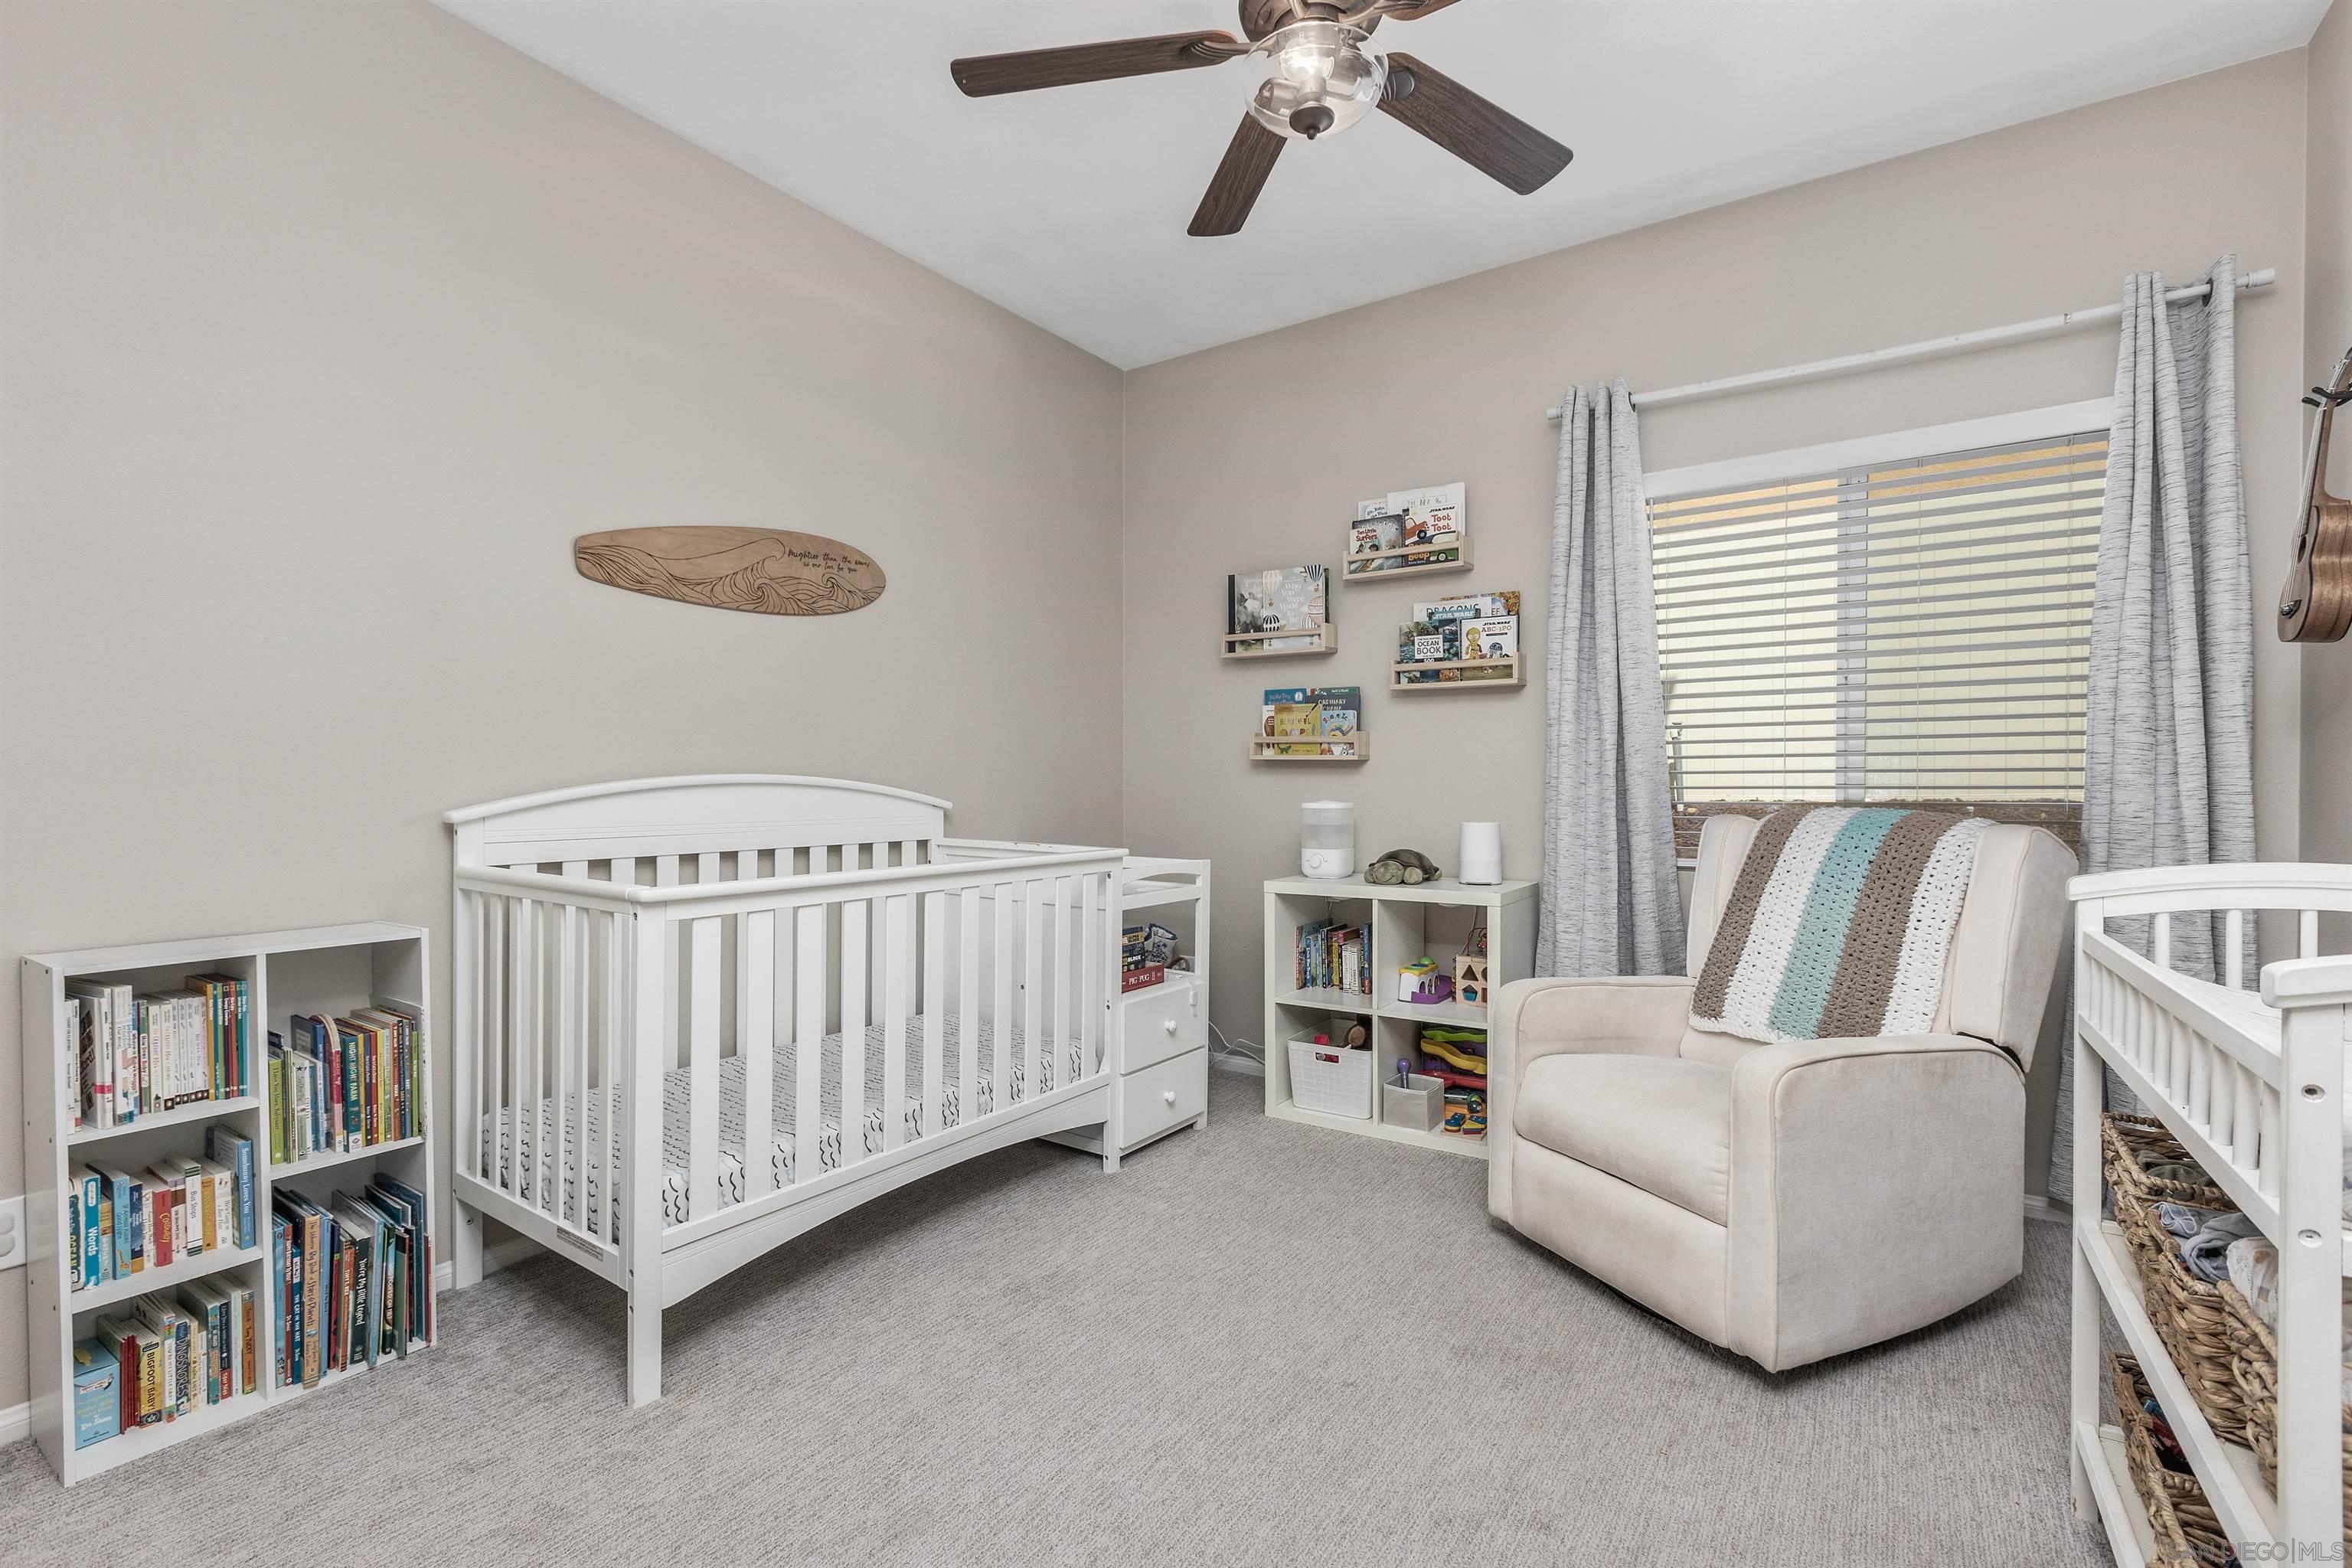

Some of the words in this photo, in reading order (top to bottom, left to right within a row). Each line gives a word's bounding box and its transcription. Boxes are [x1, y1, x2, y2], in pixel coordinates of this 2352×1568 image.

[1431, 513, 1452, 522] Toot
[1431, 523, 1452, 532] Toot
[822, 553, 837, 562] than
[842, 555, 851, 564] the
[1285, 583, 1302, 591] Who
[1279, 603, 1298, 611] Made
[1139, 974, 1149, 982] PUG
[350, 1083, 358, 1101] FARM
[240, 1148, 250, 1183] Somebunny
[159, 1213, 172, 1243] CORDUROY
[87, 1227, 98, 1256] Words
[307, 1251, 317, 1261] Big
[308, 1262, 317, 1274] Book
[357, 1258, 368, 1277] You're
[307, 1280, 317, 1297] Stars
[356, 1278, 366, 1288] My
[357, 1288, 366, 1303] Little
[307, 1302, 318, 1327] Planets
[355, 1304, 365, 1325] Legend
[176, 1337, 188, 1397] DINOSNORES
